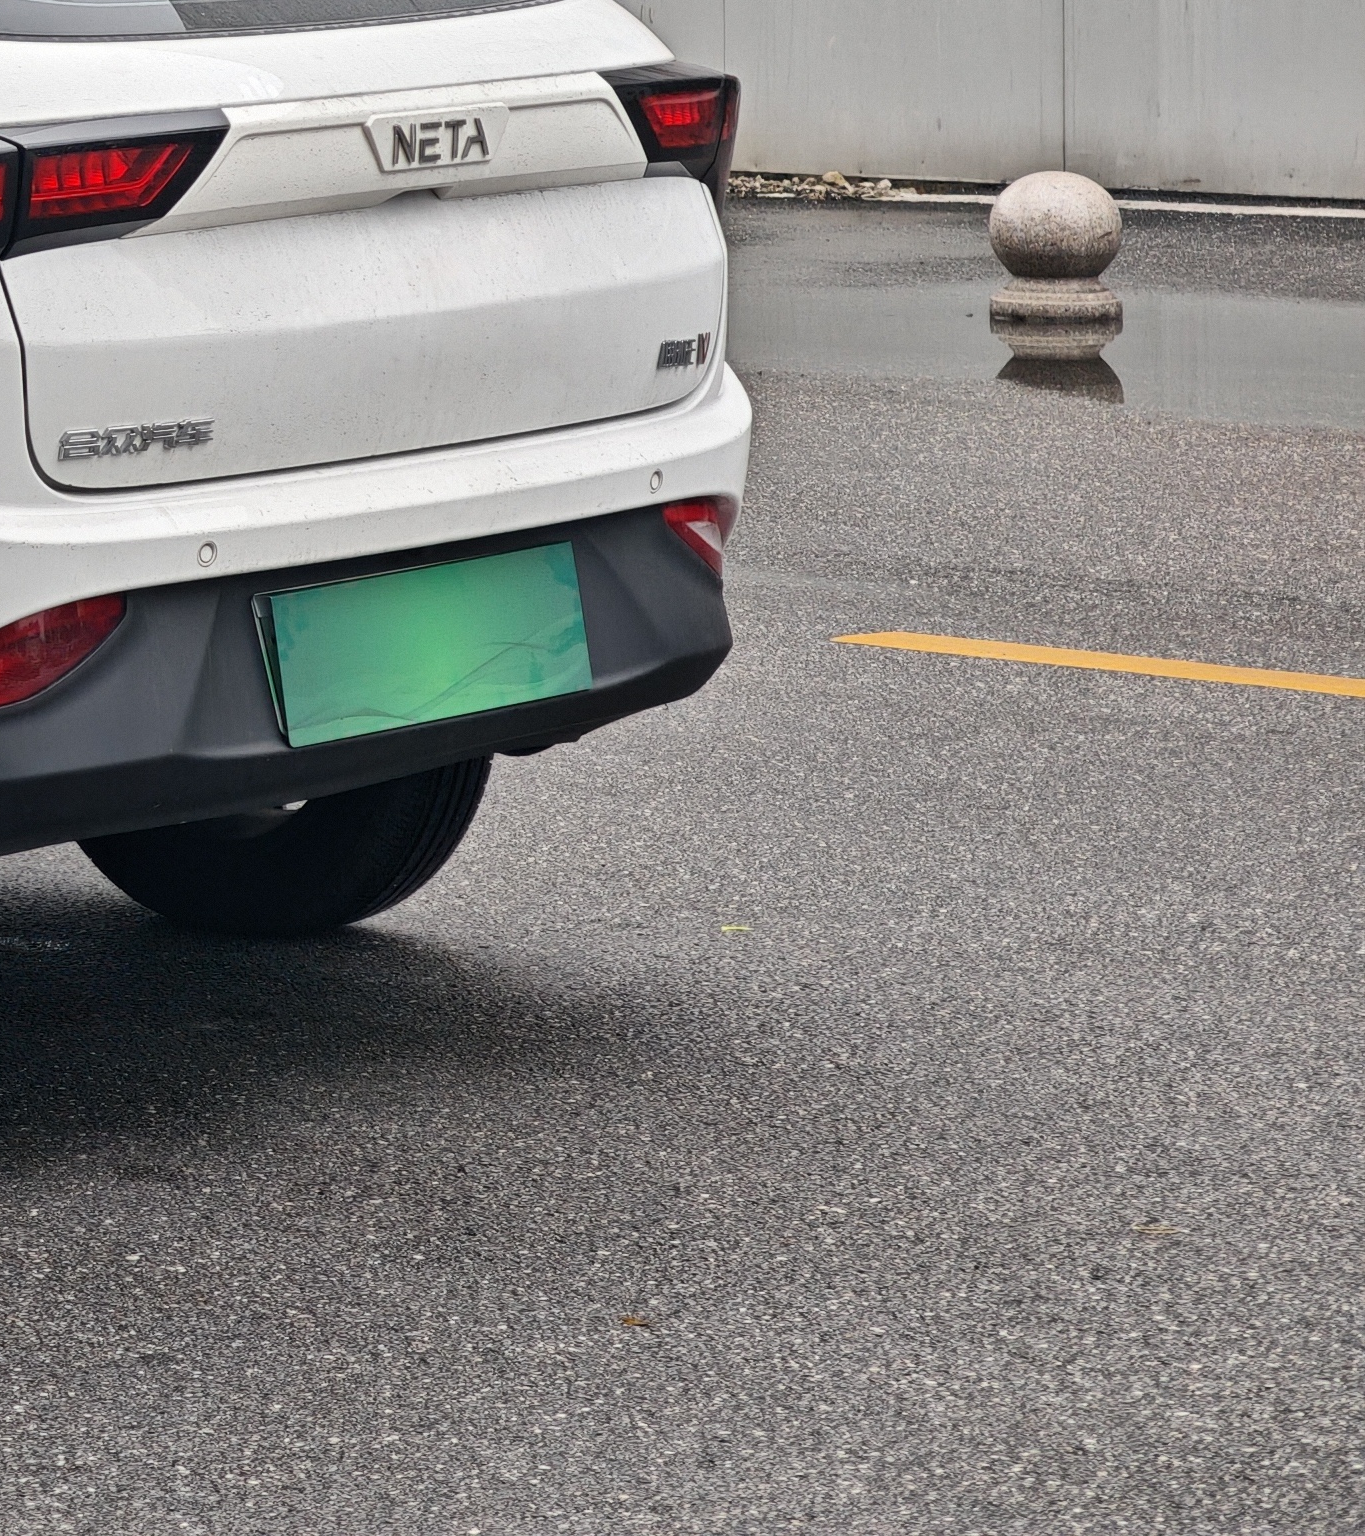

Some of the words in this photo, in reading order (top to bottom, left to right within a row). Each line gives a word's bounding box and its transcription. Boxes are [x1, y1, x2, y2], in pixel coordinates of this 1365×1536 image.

[392, 117, 489, 167] NETA
[58, 417, 215, 462] 合众汽车
